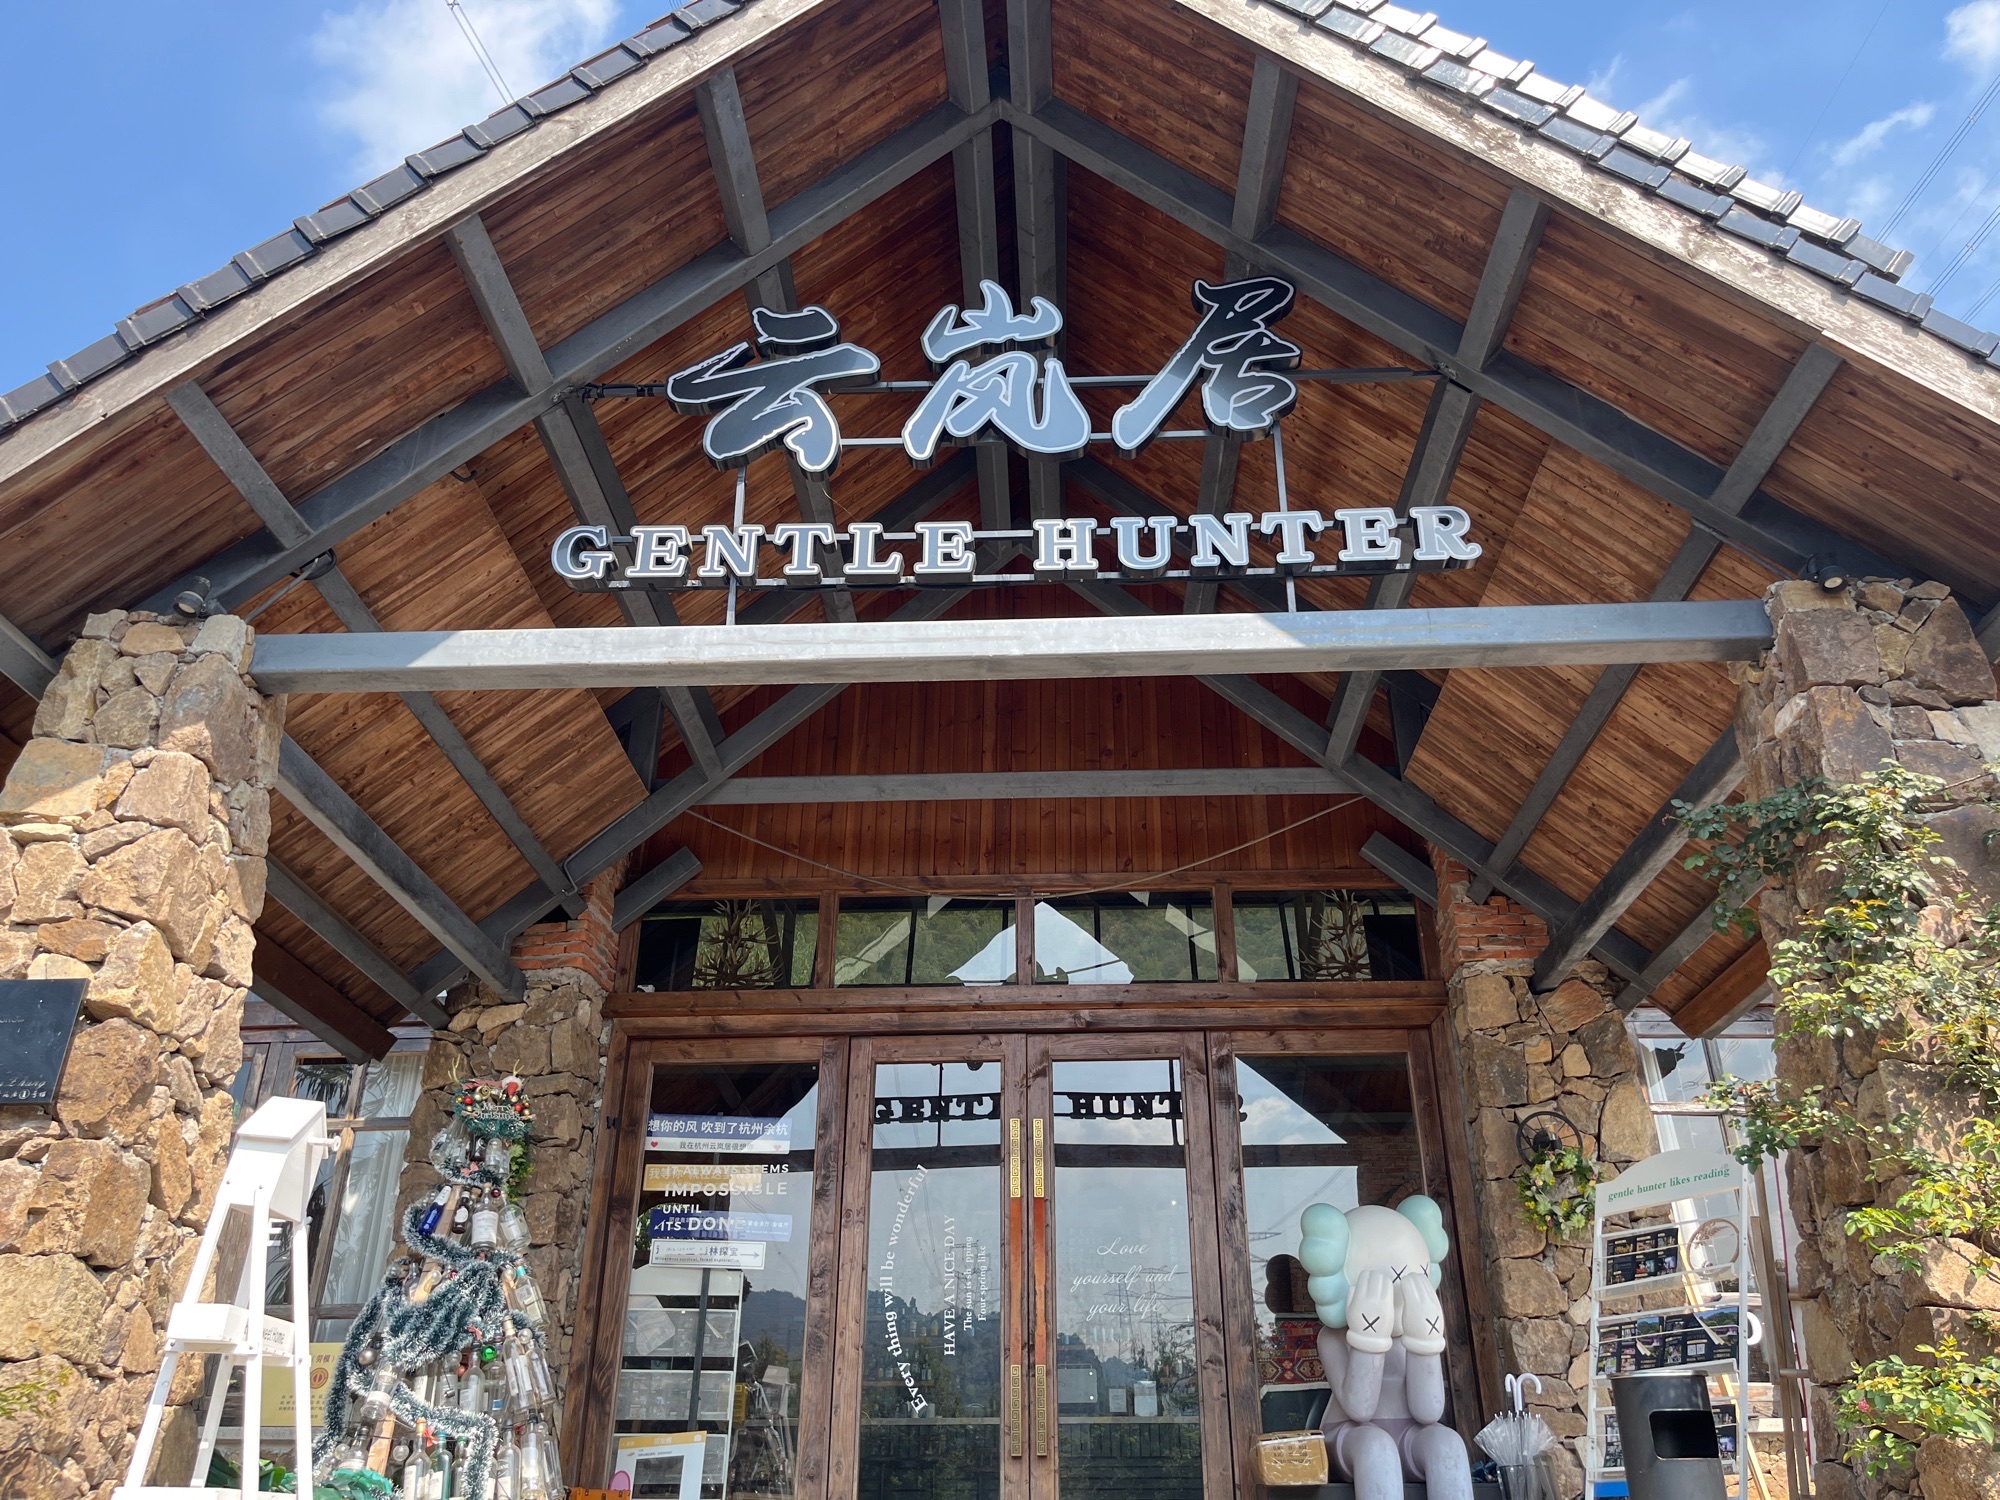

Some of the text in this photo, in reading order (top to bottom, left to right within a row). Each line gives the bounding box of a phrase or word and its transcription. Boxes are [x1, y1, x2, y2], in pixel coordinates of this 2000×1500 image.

[666, 278, 1302, 472] 云岚居
[551, 506, 1482, 580] GENTLE HUNTER
[648, 1120, 788, 1136] 想你的风 吹到了杭州余杭
[683, 1165, 738, 1175] ALWAYS
[744, 1163, 790, 1174] SEEMS
[664, 1182, 788, 1197] IMPOSSIBLE
[1608, 1166, 1731, 1203] gentle hunter likes reading
[662, 1204, 702, 1214] UNTIL
[688, 1216, 745, 1231] DONE
[977, 1245, 986, 1262] like
[1097, 1237, 1148, 1256] Love
[879, 1163, 929, 1414] Every thing will be wonderful
[943, 1214, 956, 1356] HAVE A NICE DAY
[1069, 1264, 1179, 1293] yourself and
[977, 1297, 987, 1322] Four
[1086, 1293, 1162, 1322] your life
[963, 1310, 973, 1332] The
